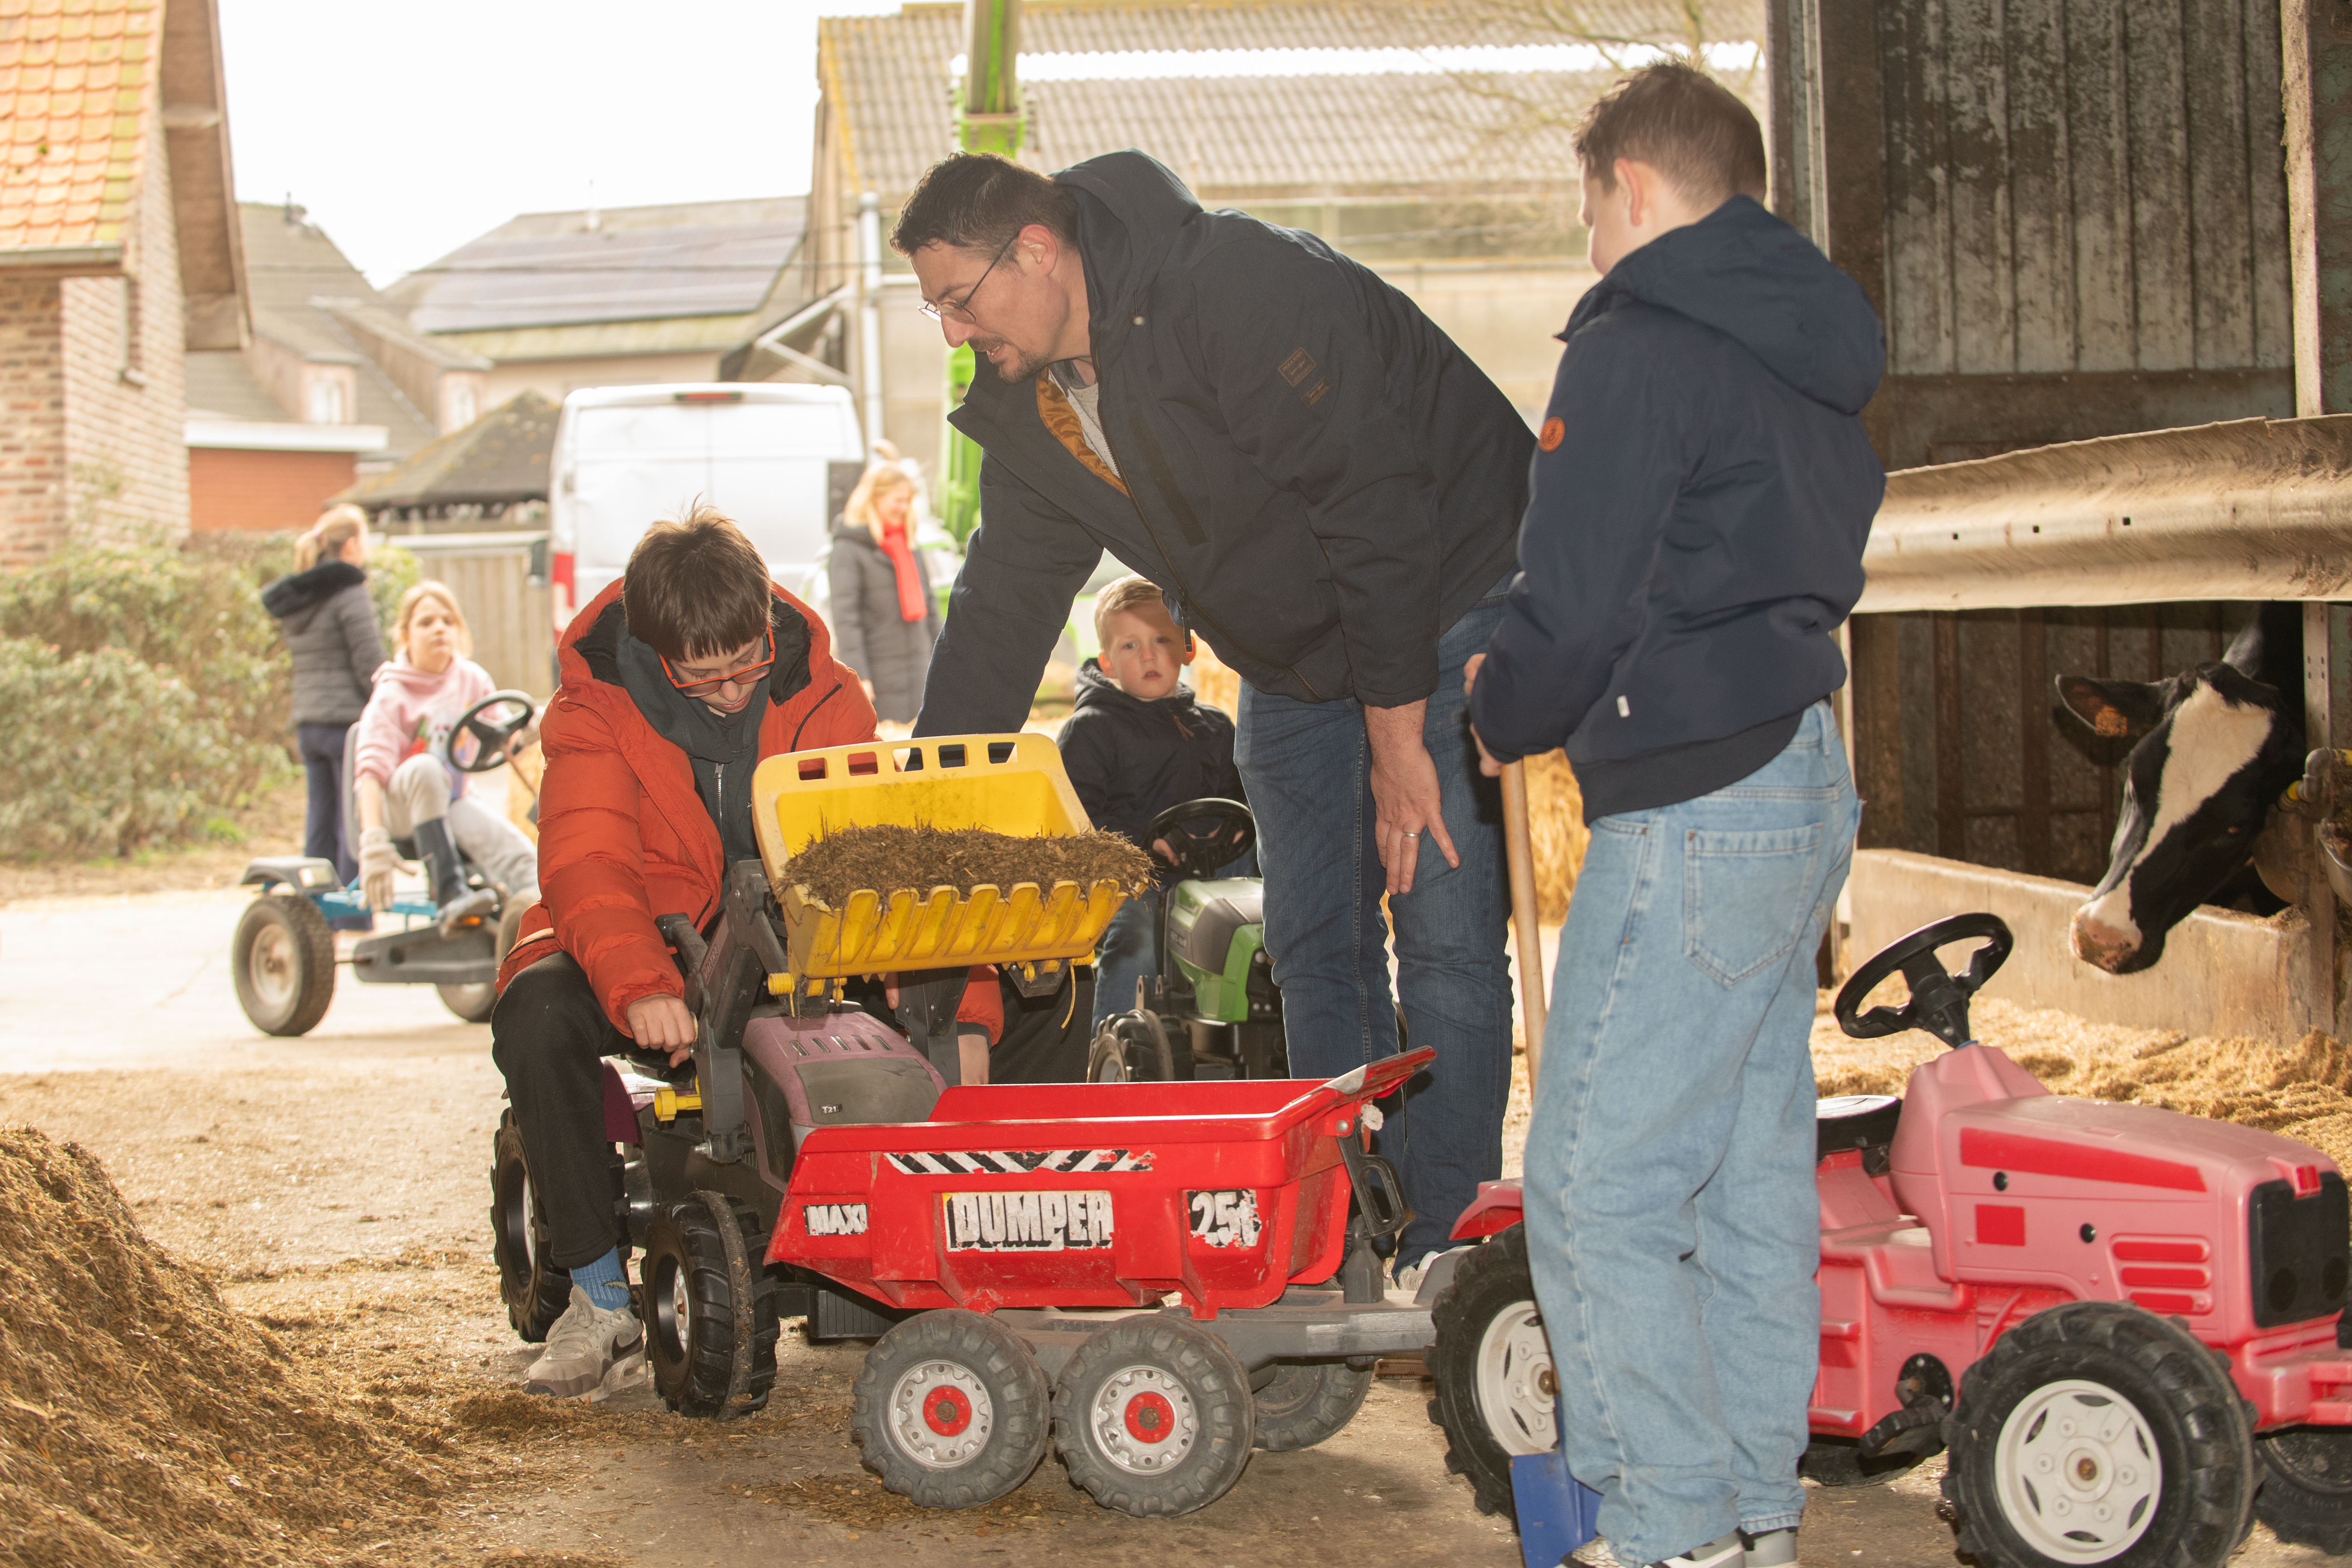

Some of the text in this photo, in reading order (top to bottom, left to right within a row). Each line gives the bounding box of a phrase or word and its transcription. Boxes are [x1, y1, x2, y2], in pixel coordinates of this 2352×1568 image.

[822, 1105, 839, 1113] T21
[806, 1204, 868, 1235] MAXI
[947, 1192, 1113, 1248] DUMPER
